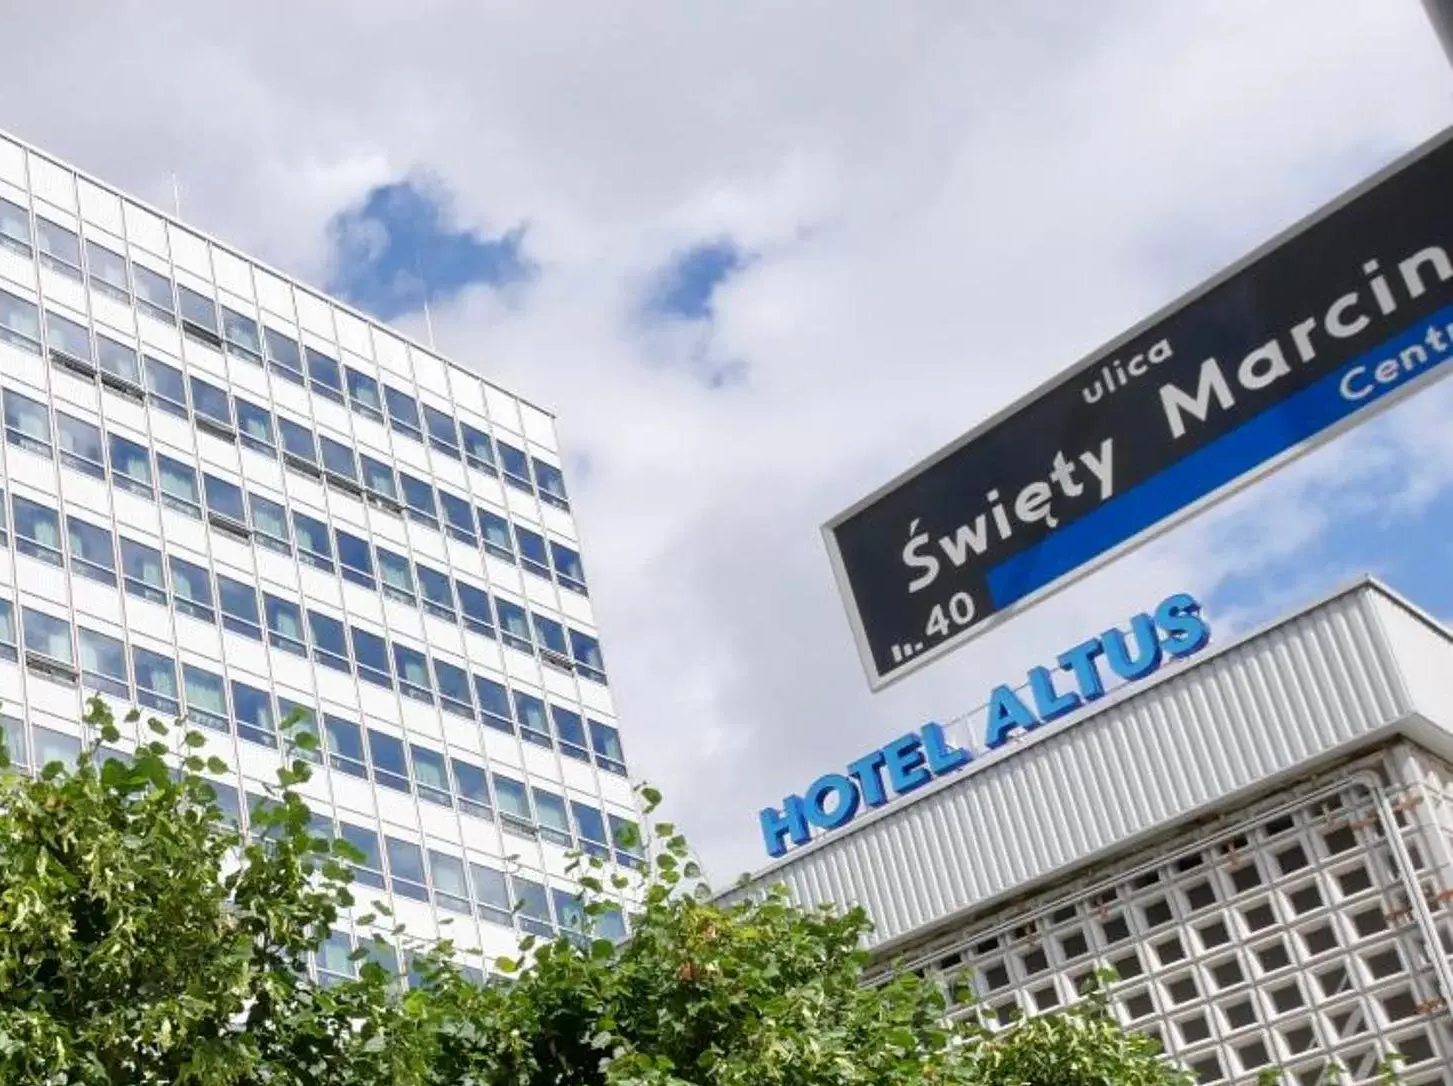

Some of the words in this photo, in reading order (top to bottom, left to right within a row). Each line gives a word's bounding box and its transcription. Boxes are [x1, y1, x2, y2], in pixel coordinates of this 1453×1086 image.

[901, 437, 1116, 594] Święty
[1158, 244, 1453, 440] Marcin
[1082, 336, 1174, 405] ulica
[925, 591, 976, 636] 40
[758, 720, 974, 859] HOTEL
[983, 592, 1213, 750] ALTUS
